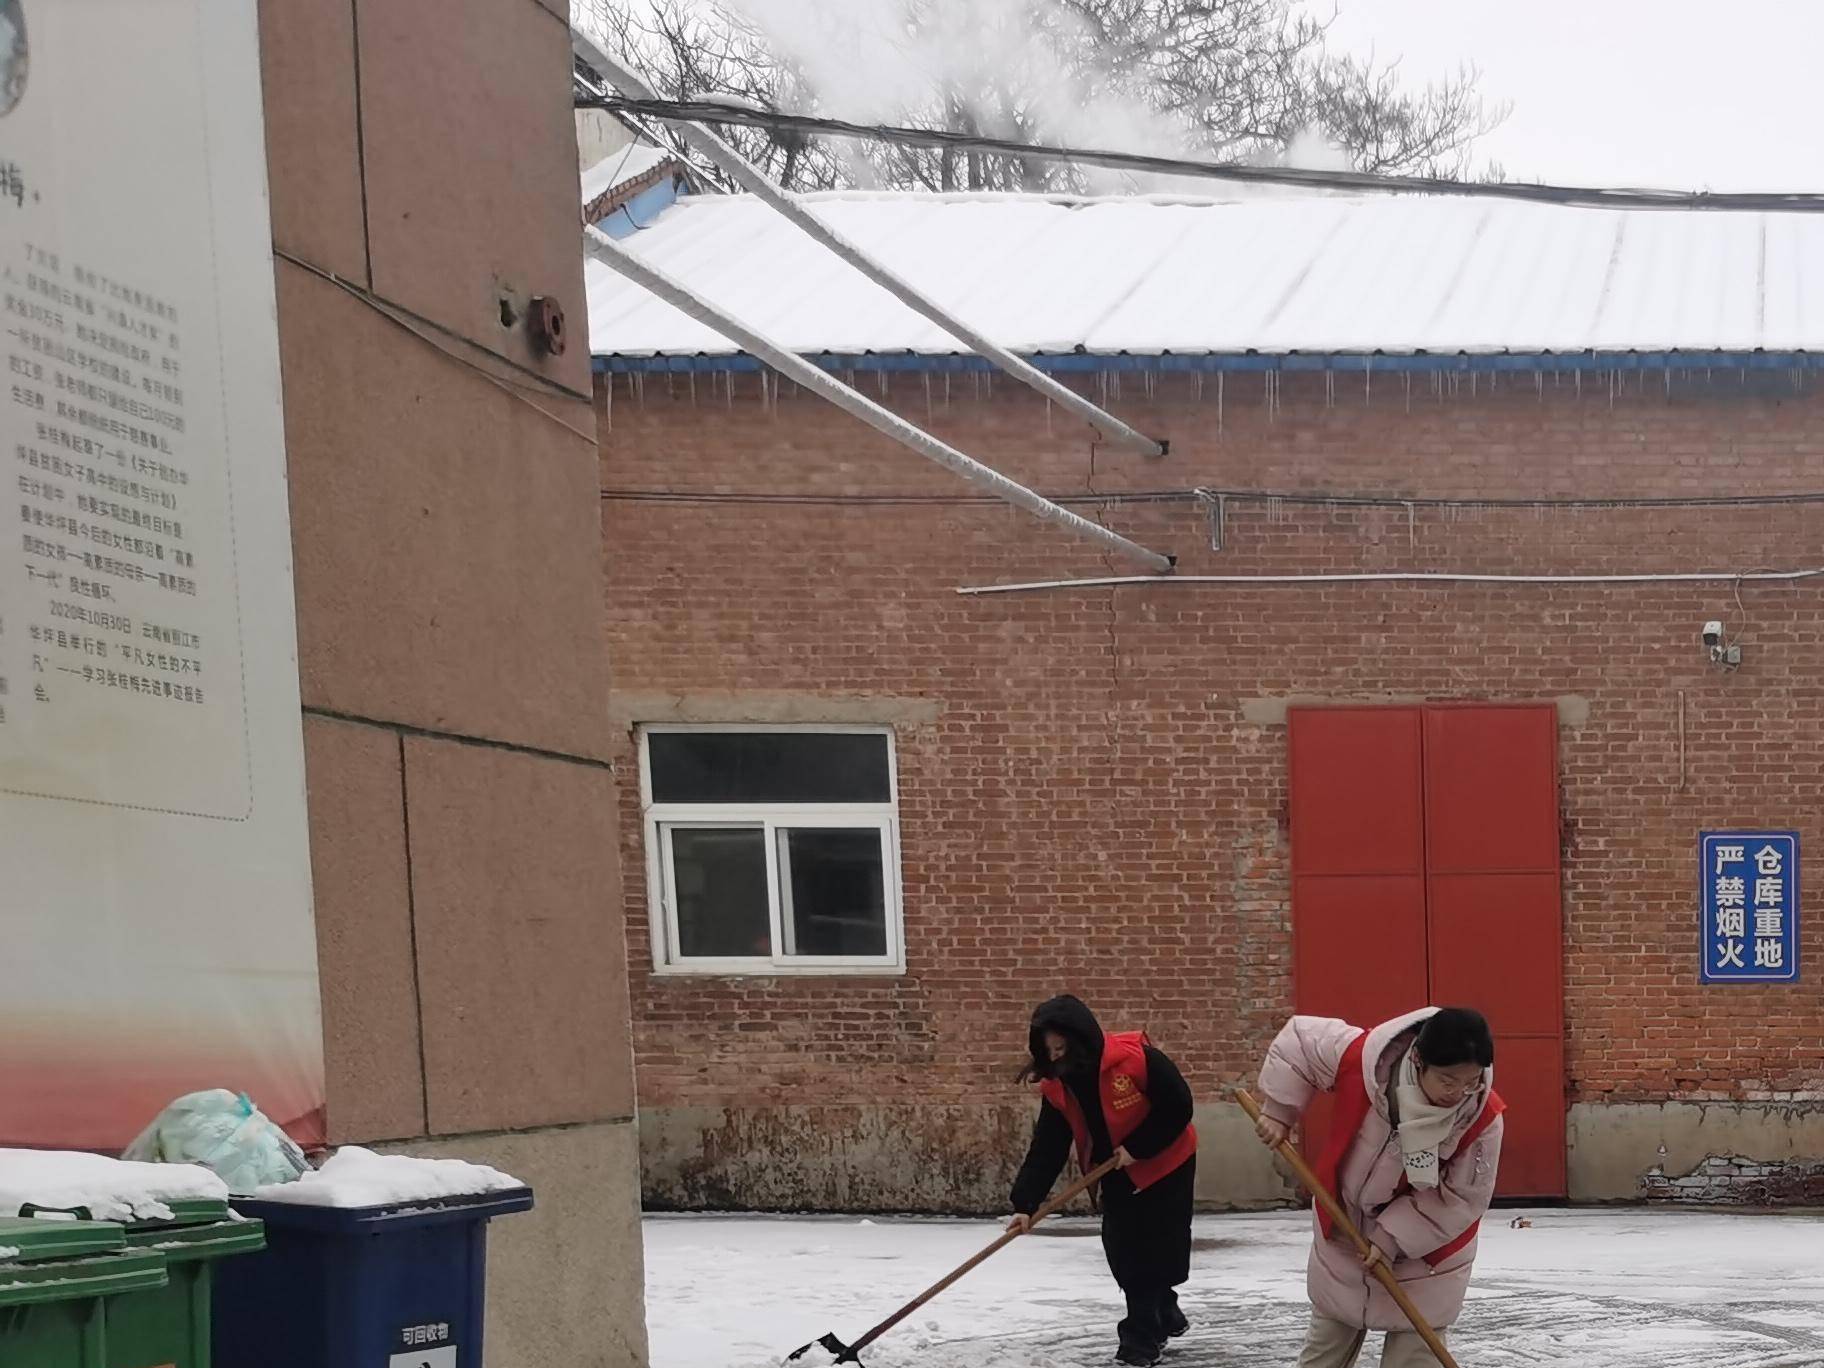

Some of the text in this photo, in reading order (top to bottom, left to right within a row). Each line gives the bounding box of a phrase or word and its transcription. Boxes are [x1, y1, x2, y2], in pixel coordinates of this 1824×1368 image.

[1715, 845, 1745, 968] 严禁烟火
[1754, 845, 1783, 968] 仓库重地
[401, 1322, 449, 1345] 可回收物
